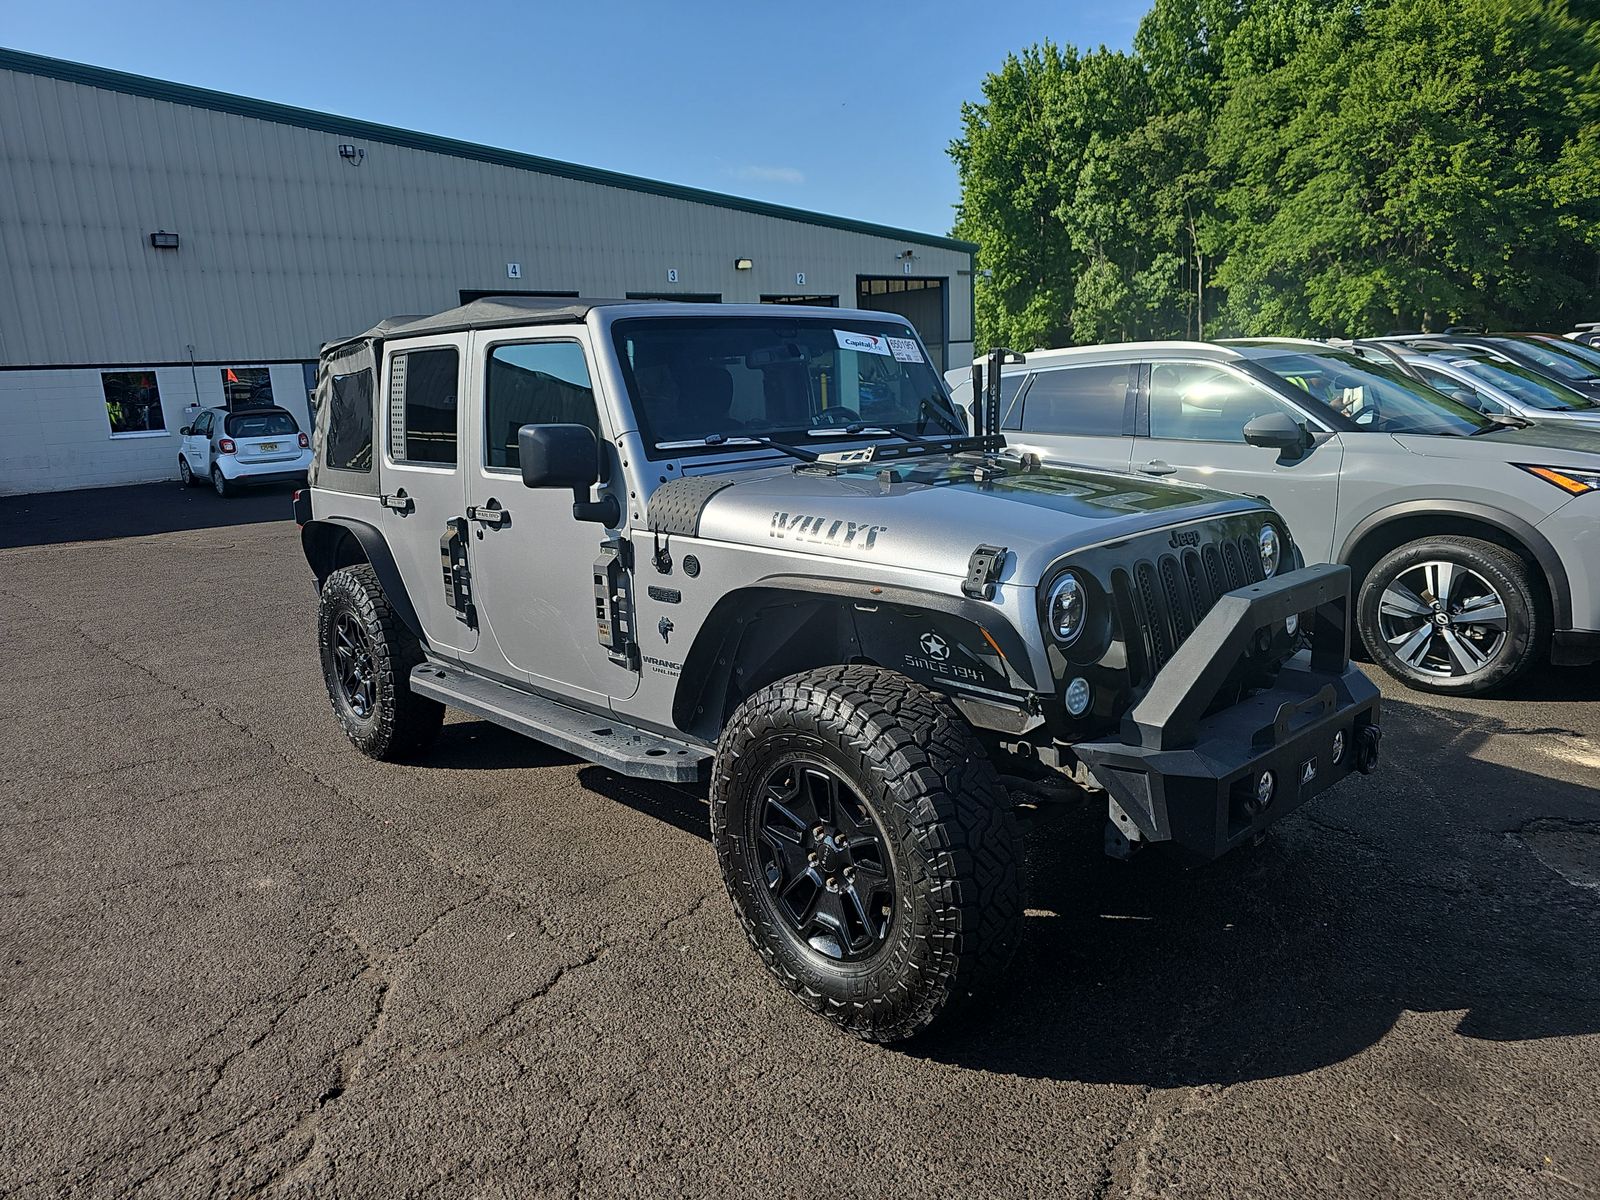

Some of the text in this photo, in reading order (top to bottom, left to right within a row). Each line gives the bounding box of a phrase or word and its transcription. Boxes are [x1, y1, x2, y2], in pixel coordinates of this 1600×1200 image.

[511, 265, 518, 277] 4
[670, 270, 676, 281] 3
[798, 273, 804, 284] 2
[845, 338, 871, 348] Capital
[769, 511, 888, 551] WILLYS
[1168, 530, 1200, 549] Jeep
[951, 665, 985, 682] 1941
